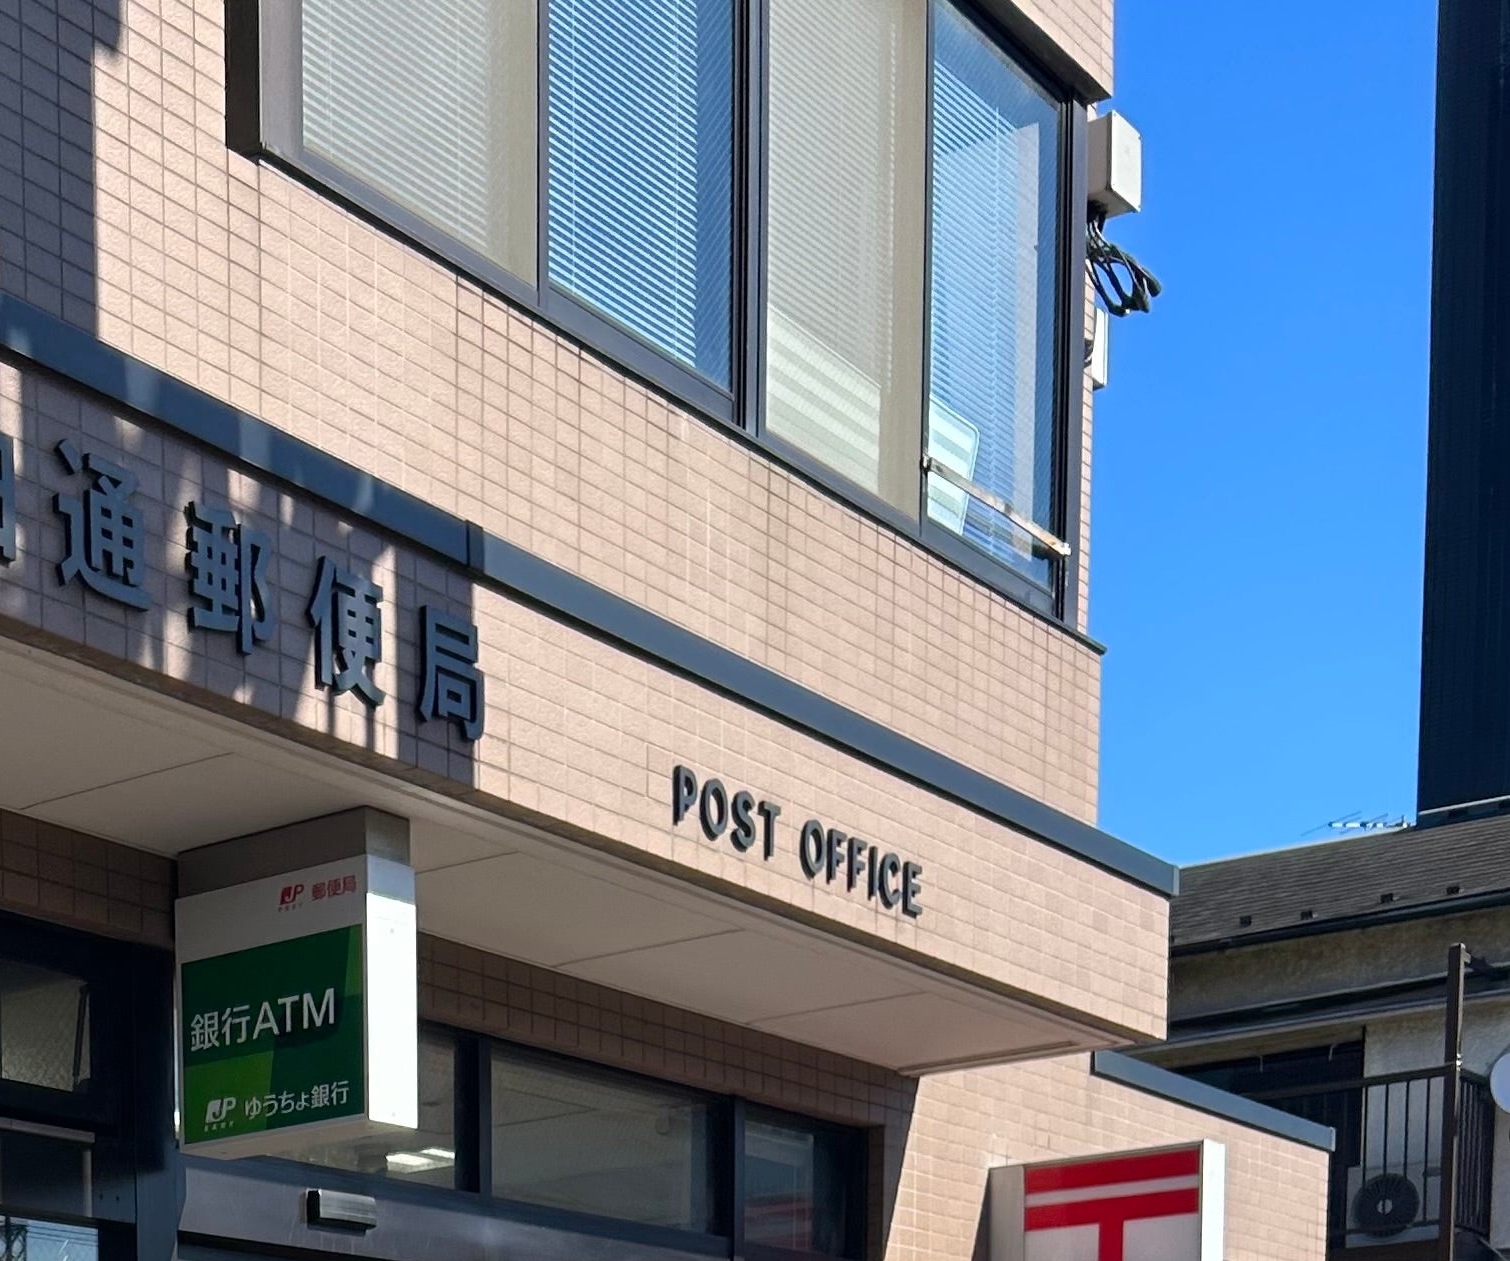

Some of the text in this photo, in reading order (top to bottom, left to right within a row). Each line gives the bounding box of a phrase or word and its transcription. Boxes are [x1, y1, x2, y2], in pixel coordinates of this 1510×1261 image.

[672, 764, 924, 920] POST OFFICE
[311, 874, 357, 902] 郵便局
[189, 987, 335, 1053] 銀行ATM
[243, 1079, 350, 1121] ゆうちょ銀行
